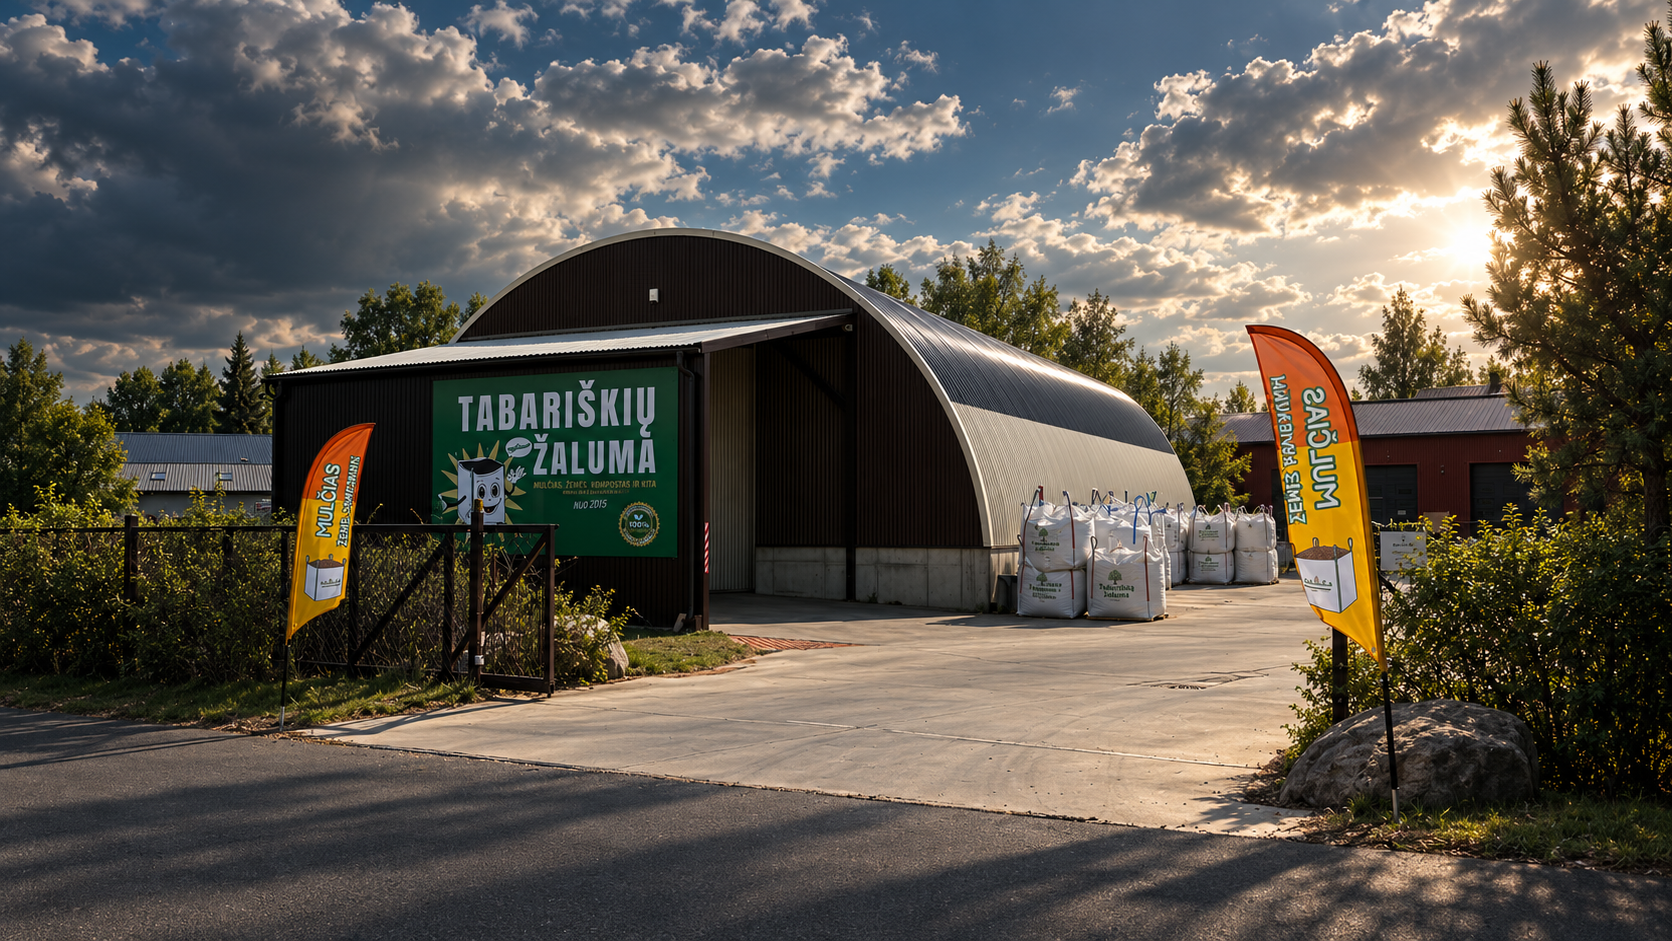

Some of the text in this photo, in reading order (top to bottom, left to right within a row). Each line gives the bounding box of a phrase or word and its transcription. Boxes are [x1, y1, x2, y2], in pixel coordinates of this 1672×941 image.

[458, 379, 656, 438] TABARIŠKIŲ
[533, 433, 656, 475] ŽALUMA
[315, 462, 341, 538] MULČIAS
[589, 499, 608, 509] 2015
